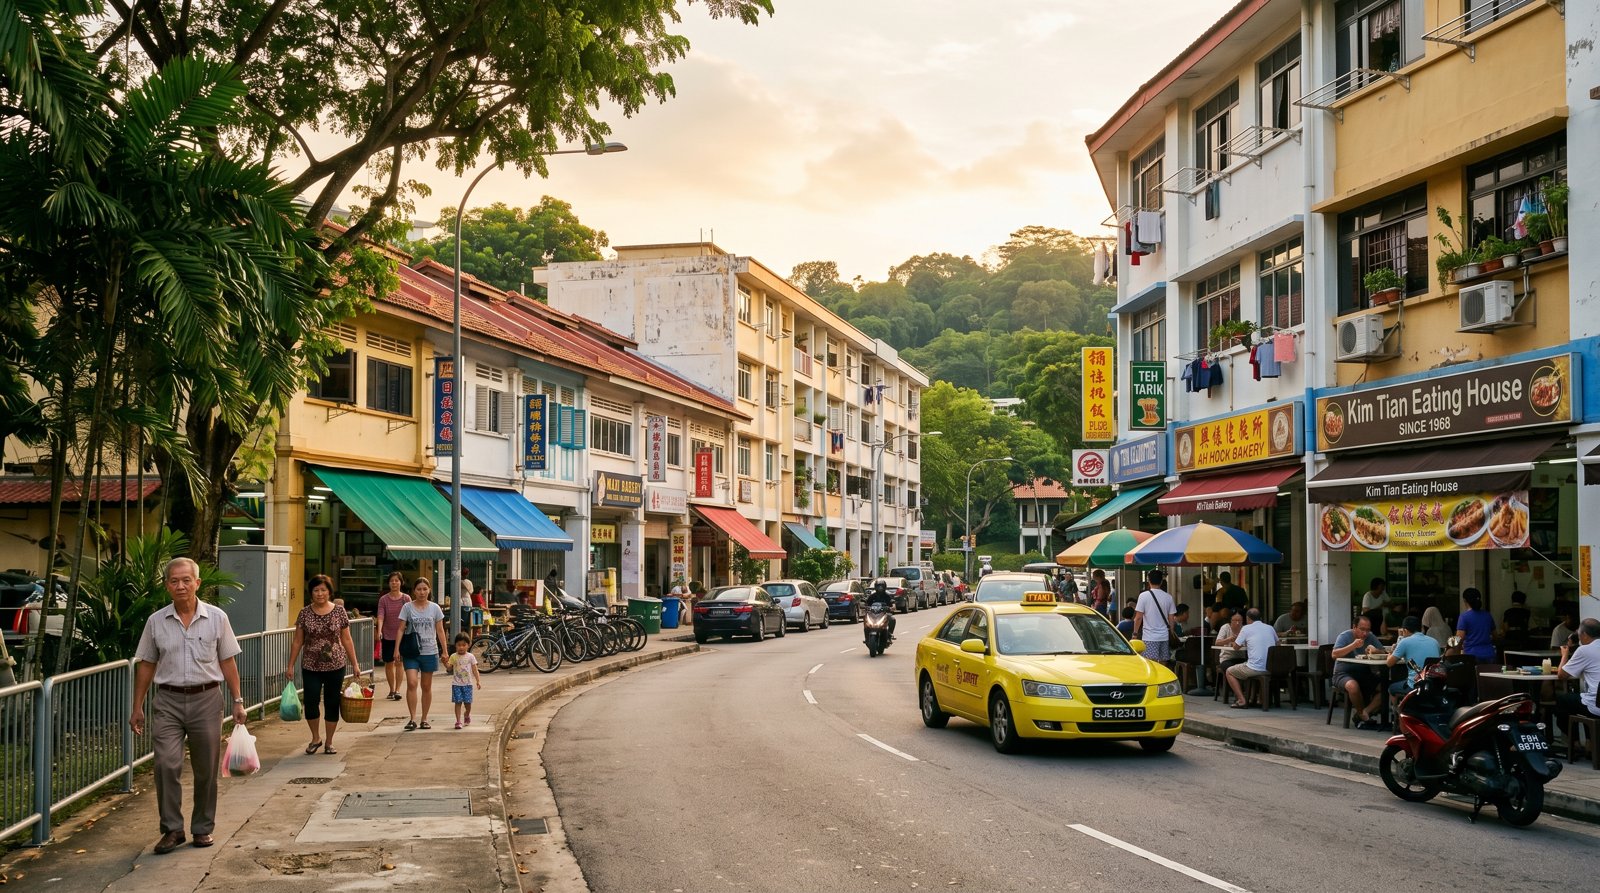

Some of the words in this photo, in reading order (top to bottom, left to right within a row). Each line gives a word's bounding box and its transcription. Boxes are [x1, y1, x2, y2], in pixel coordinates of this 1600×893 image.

[1139, 370, 1158, 382] TEH
[1134, 383, 1164, 395] TARIK
[1348, 399, 1374, 424] Kim
[1377, 394, 1408, 421] Tian
[1412, 384, 1462, 416] Eating
[1467, 378, 1523, 408] House
[1399, 419, 1427, 436] SINCE
[1429, 416, 1451, 432] 1968
[1198, 453, 1208, 465] AH
[1210, 448, 1230, 463] HOCK
[1233, 442, 1265, 460] BAKERY
[1365, 486, 1381, 497] Kim
[1383, 484, 1400, 496] Tian
[1402, 482, 1428, 496] Eating
[1430, 481, 1459, 493] House
